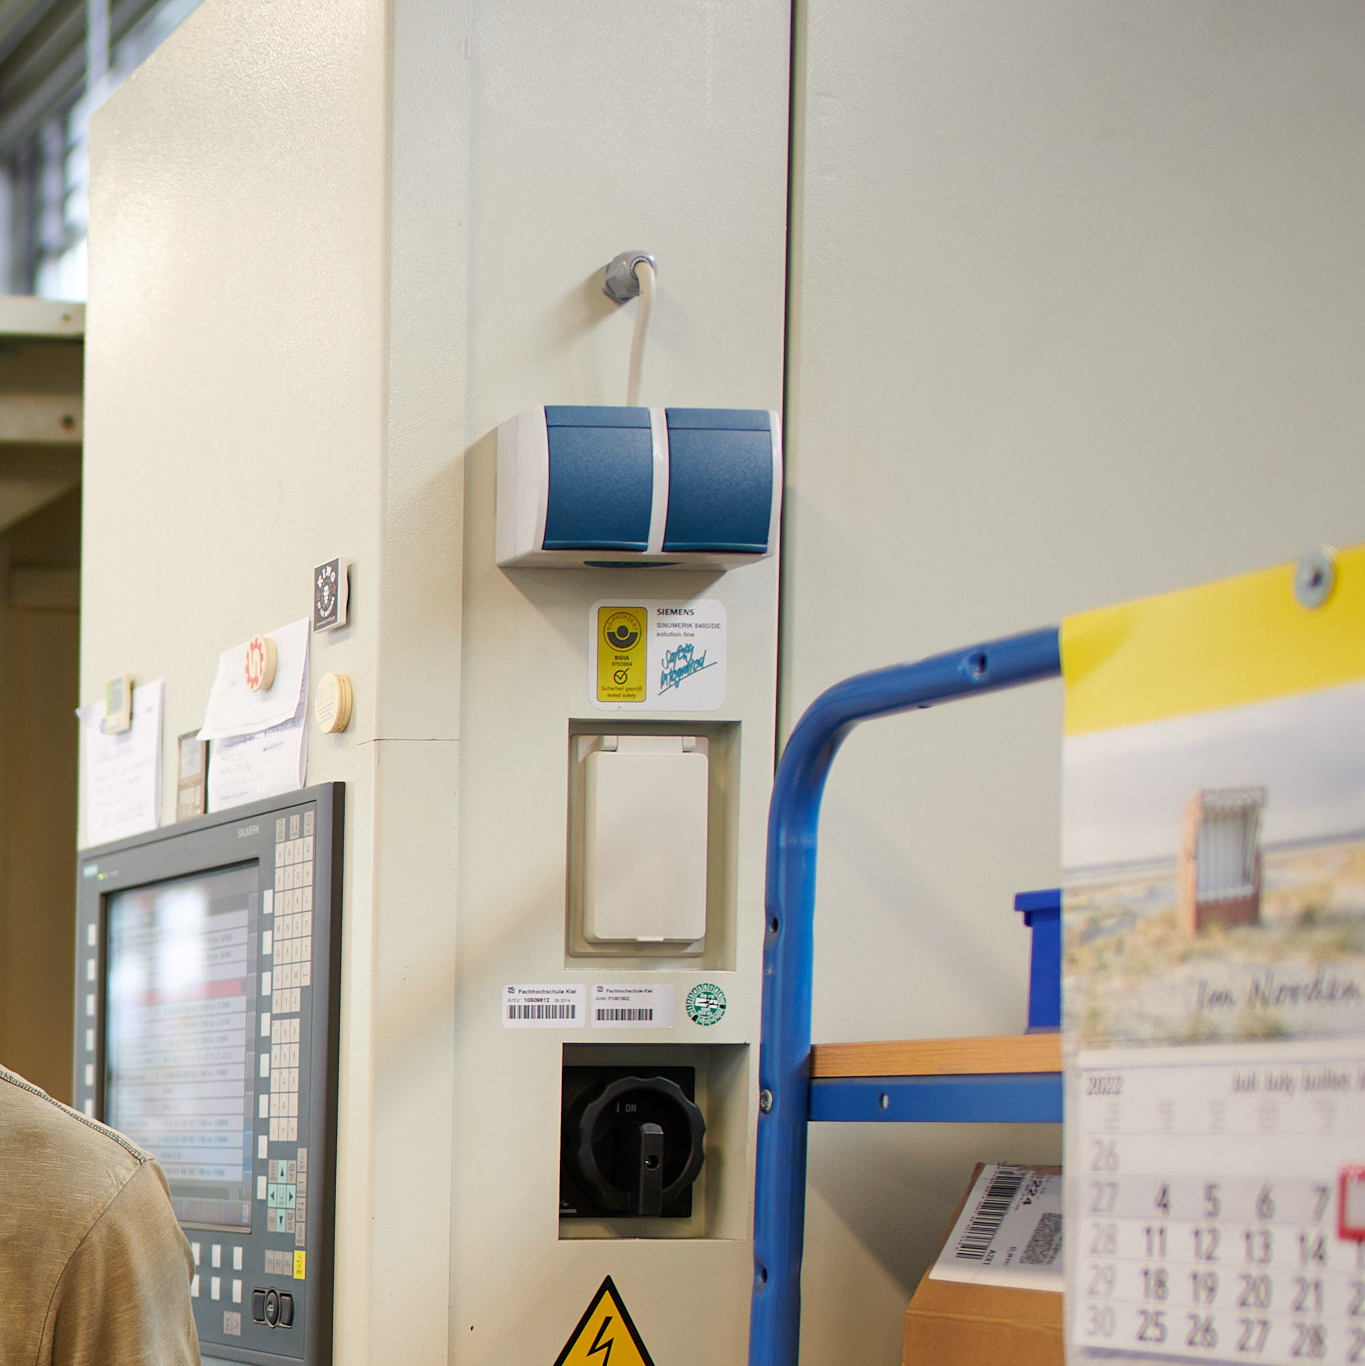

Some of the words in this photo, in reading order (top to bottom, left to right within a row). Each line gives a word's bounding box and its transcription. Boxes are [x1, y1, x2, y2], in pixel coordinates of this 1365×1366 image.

[1085, 1076, 1125, 1096] 2022
[625, 1103, 637, 1113] ON
[1090, 1141, 1120, 1171] 26
[1089, 1182, 1118, 1213] 27
[1155, 1184, 1171, 1215] 4
[1205, 1185, 1221, 1218] 5
[1257, 1186, 1274, 1220] 6
[1313, 1187, 1330, 1222] 7
[1090, 1225, 1117, 1255] 28
[1144, 1227, 1168, 1258] 11
[1193, 1228, 1221, 1261] 12
[1244, 1231, 1272, 1264] 13
[1298, 1233, 1328, 1266] 14
[1088, 1265, 1116, 1297] 29
[1141, 1269, 1169, 1300] 18
[1191, 1270, 1219, 1304] 19
[1237, 1274, 1272, 1309] 20
[1292, 1278, 1323, 1313] 21
[1085, 1305, 1115, 1338] 30
[1136, 1311, 1167, 1343] 25
[1186, 1314, 1218, 1349] 26
[1237, 1319, 1270, 1353] 27
[1291, 1323, 1326, 1359] 28
